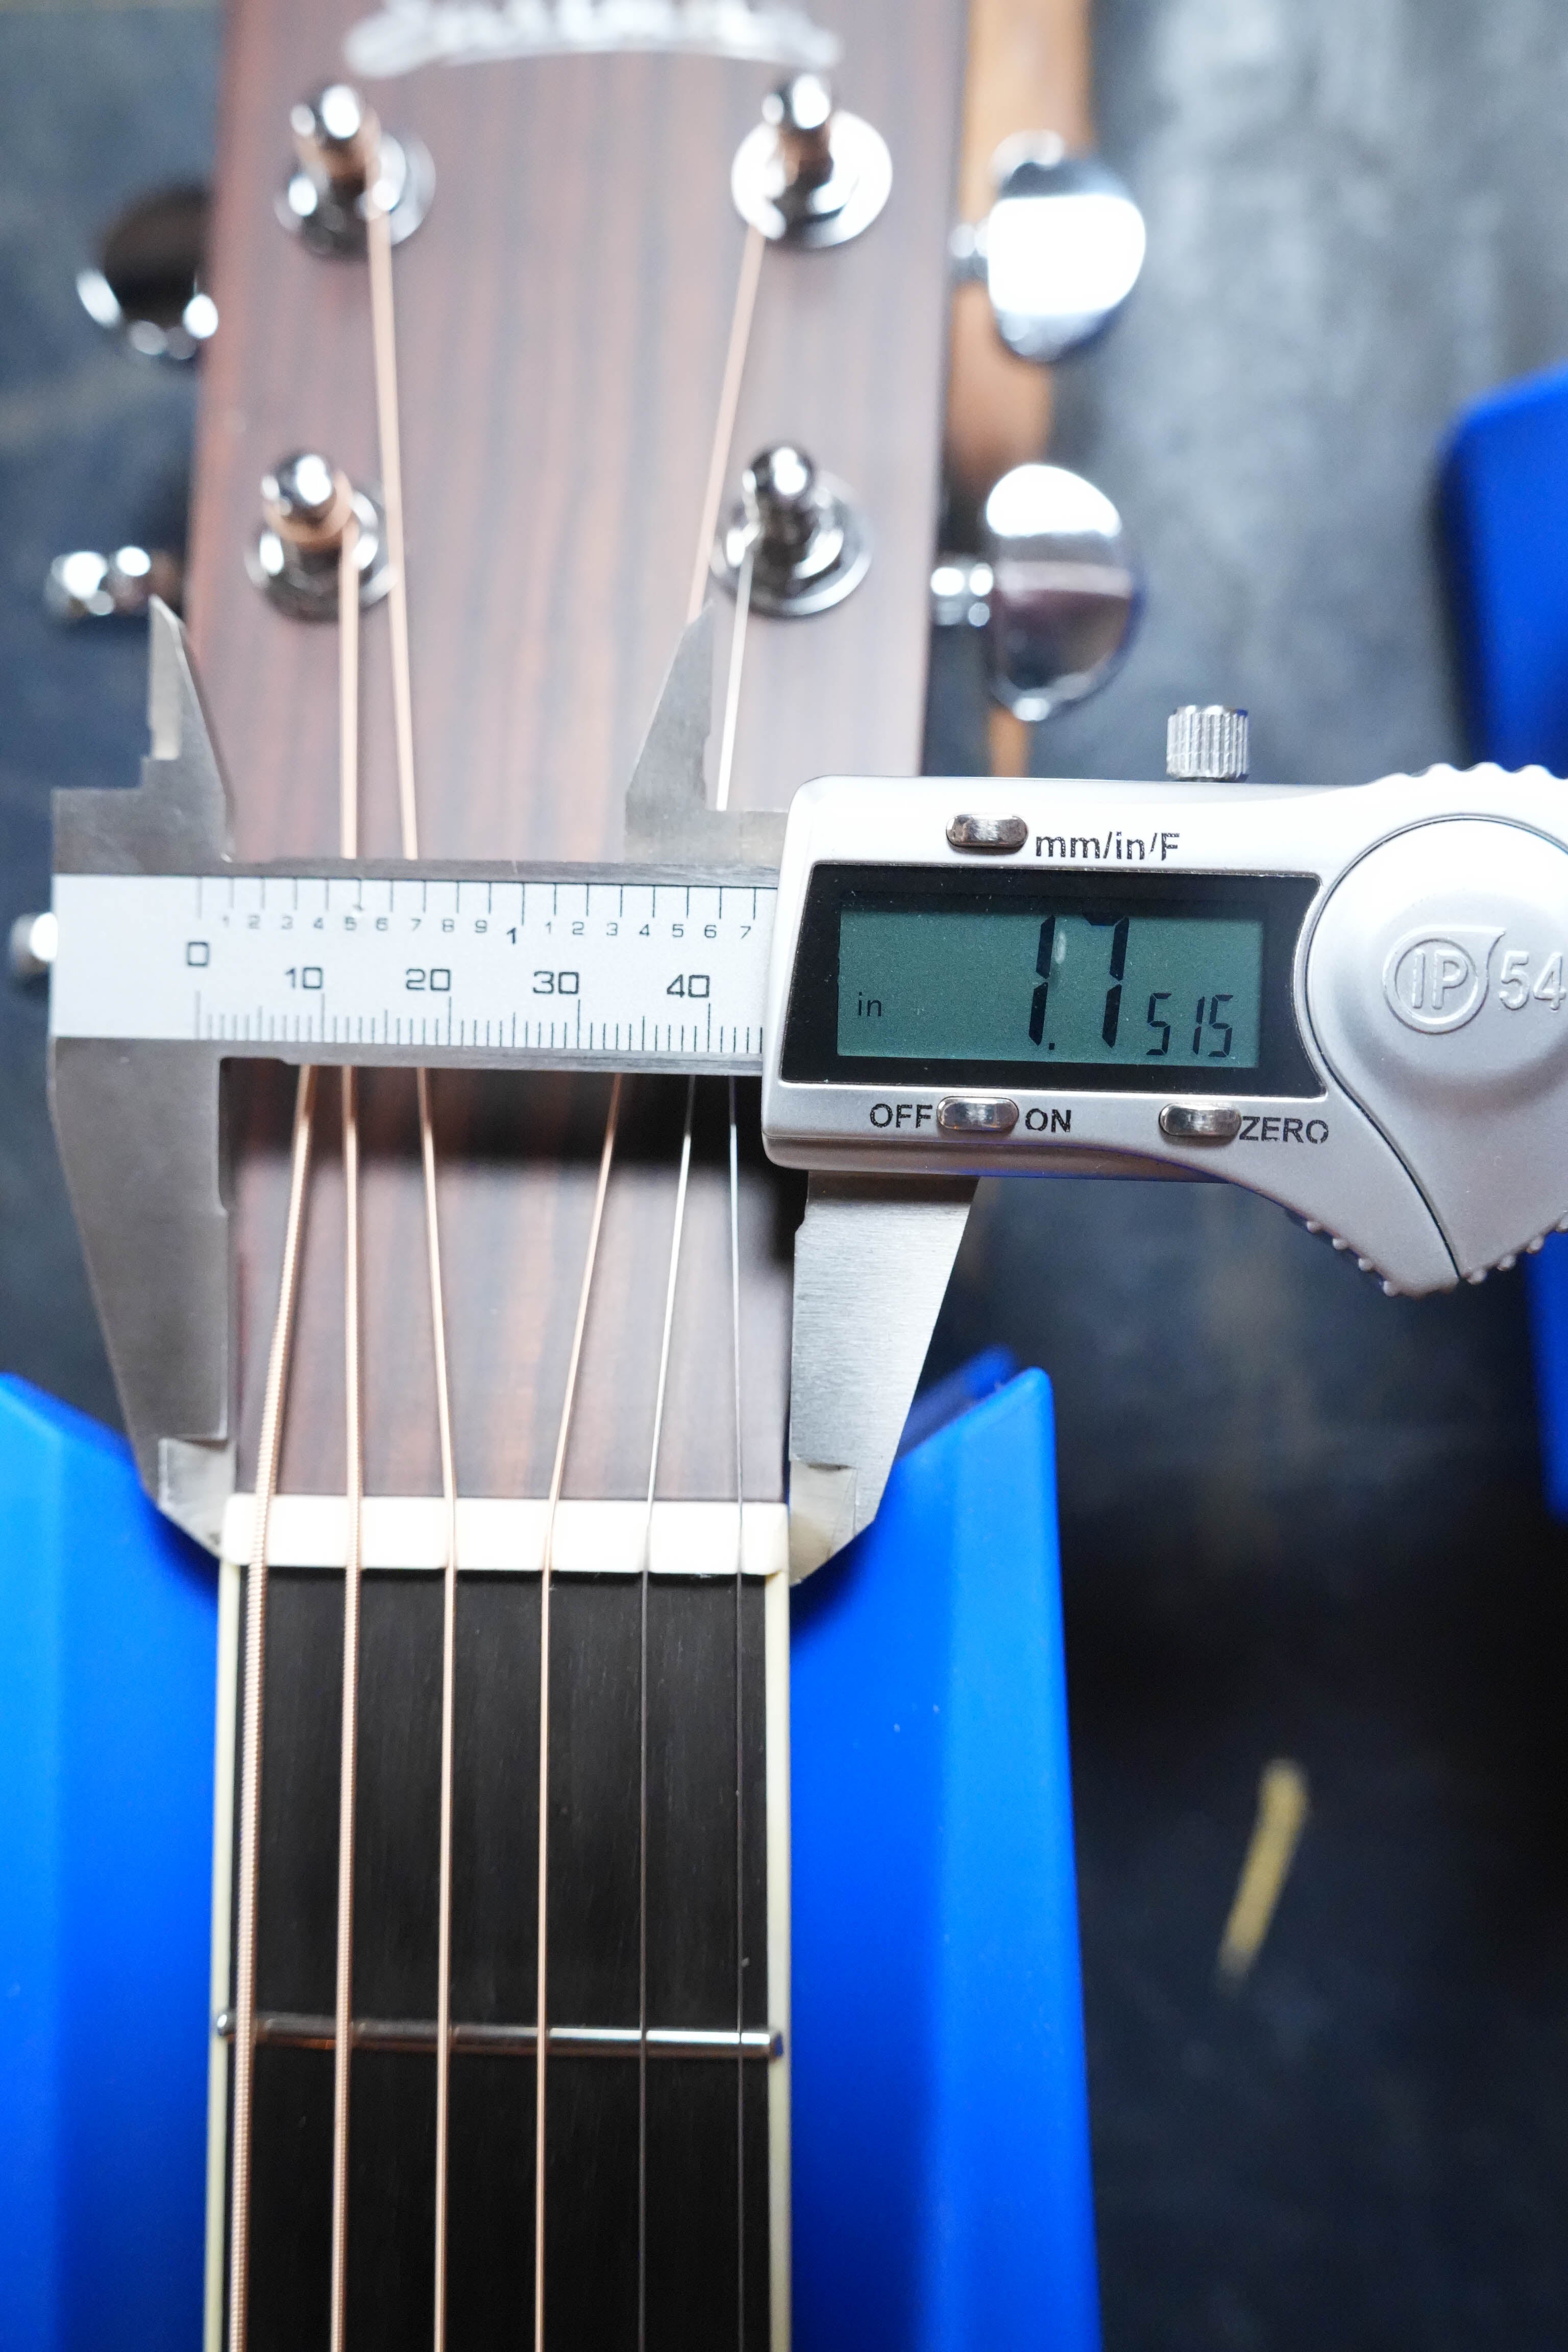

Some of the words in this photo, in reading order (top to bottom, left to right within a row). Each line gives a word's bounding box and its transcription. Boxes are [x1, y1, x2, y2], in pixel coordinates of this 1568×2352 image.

[1036, 830, 1180, 861] mm/in/F
[222, 915, 230, 928] 1
[249, 915, 259, 929] 2
[281, 916, 293, 929] 3
[313, 917, 324, 929] 4
[344, 916, 357, 931] 5
[376, 917, 388, 931] 6
[411, 918, 422, 931] 7
[442, 918, 454, 933] 8
[475, 919, 487, 934] 9
[506, 926, 518, 945] 1
[545, 921, 552, 934] 1
[572, 921, 584, 936] 2
[606, 922, 618, 936] 3
[638, 923, 651, 938] 4
[672, 923, 684, 938] 5
[704, 924, 717, 939] 6
[740, 925, 752, 940] 7
[284, 966, 324, 991] 10
[405, 967, 452, 992] 20
[531, 970, 580, 995] 30
[666, 974, 710, 999] 40
[1411, 948, 1468, 1010] IP
[1498, 950, 1567, 1012] 54
[856, 991, 885, 1019] in
[868, 1102, 933, 1129] OFF
[1025, 1107, 1072, 1134] ON
[1239, 1116, 1329, 1144] ZERO
